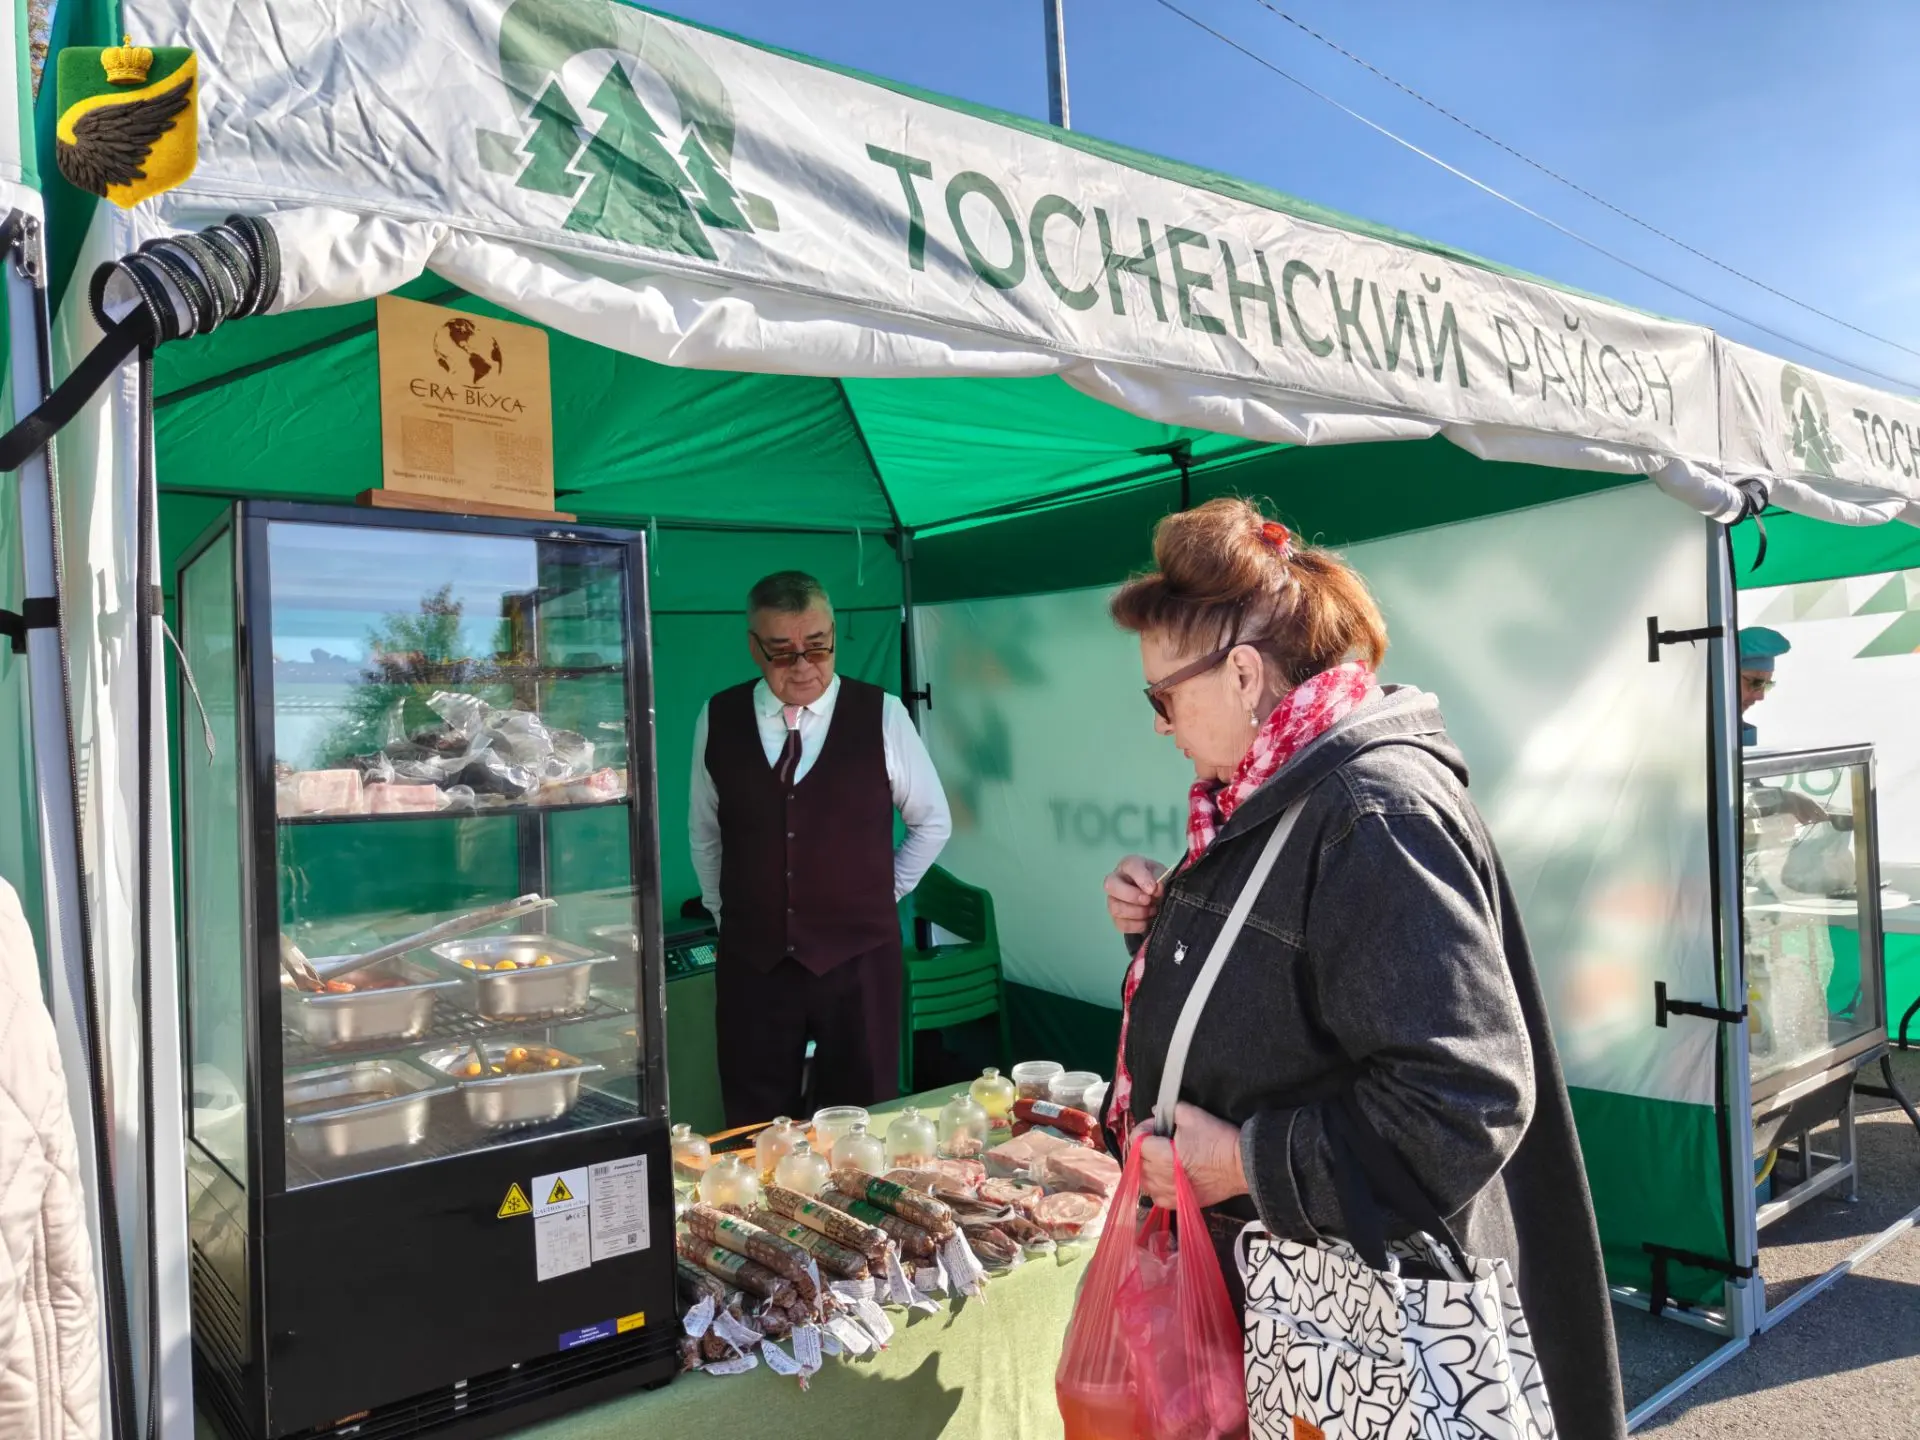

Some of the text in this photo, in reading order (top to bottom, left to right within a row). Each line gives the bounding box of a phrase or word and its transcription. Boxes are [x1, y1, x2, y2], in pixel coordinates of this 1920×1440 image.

[865, 143, 1675, 426] ТОСНЕНСКИЙ РАЙОН
[465, 389, 527, 413] ВКУСА
